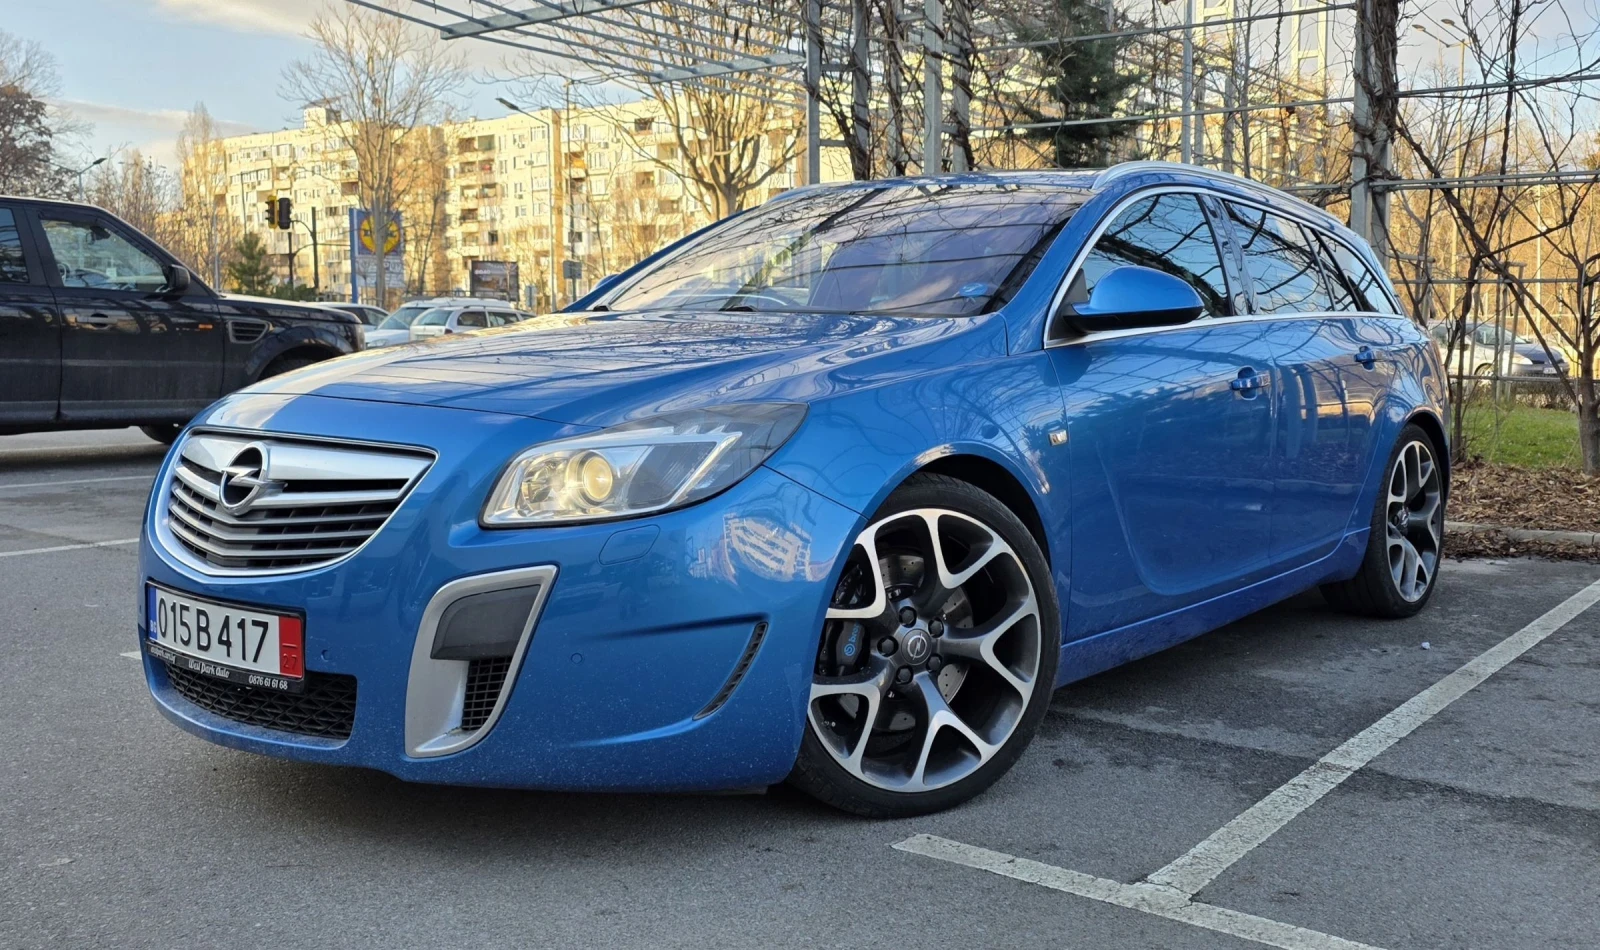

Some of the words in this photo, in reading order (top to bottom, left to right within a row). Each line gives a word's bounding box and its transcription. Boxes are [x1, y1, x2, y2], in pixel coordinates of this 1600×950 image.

[150, 620, 157, 634] BG
[158, 597, 269, 663] 015B417
[200, 661, 215, 674] Park
[283, 653, 297, 671] 27
[279, 680, 288, 690] 68
